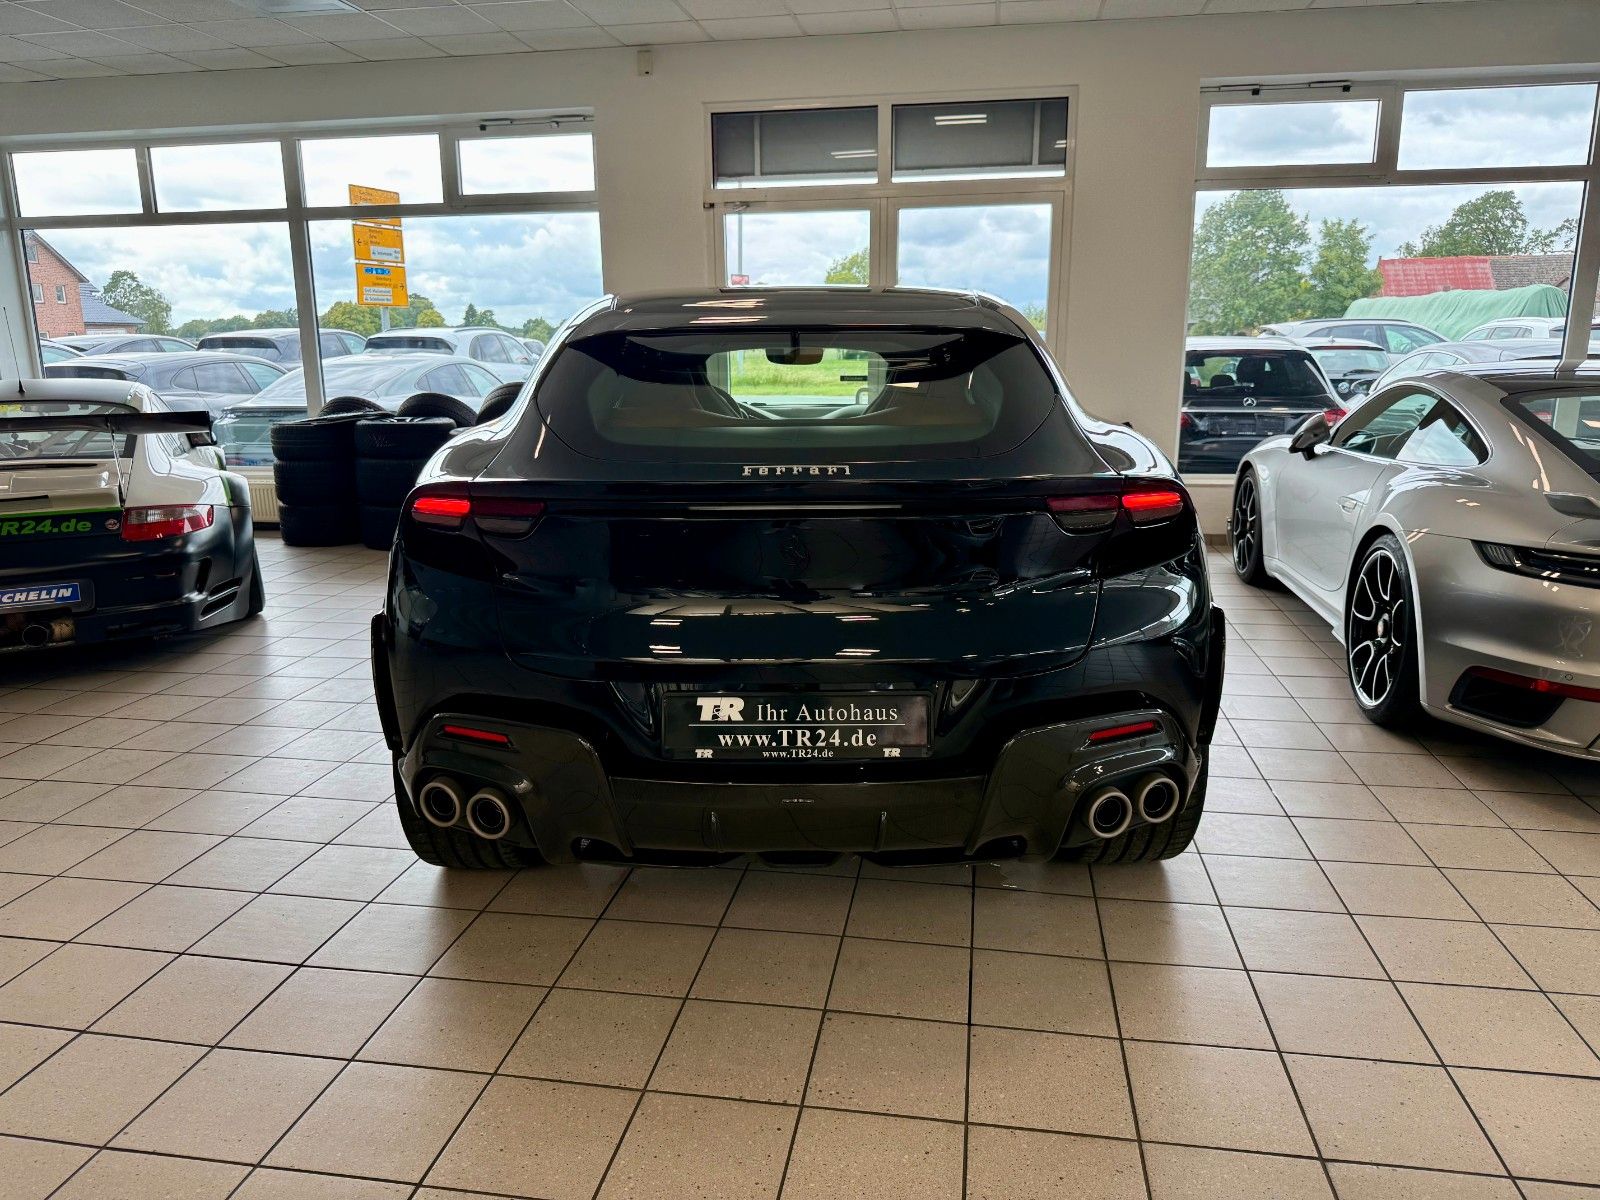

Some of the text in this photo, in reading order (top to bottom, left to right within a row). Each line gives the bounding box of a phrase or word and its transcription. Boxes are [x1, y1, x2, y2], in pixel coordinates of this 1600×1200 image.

[742, 465, 851, 476] Ferrari
[0, 518, 92, 536] R24.de
[0, 587, 72, 603] CHELIN
[757, 704, 788, 721] Ihr
[797, 703, 899, 721] Autohaus
[718, 729, 877, 747] www.TR24.de
[762, 750, 834, 758] www.TR24.de
